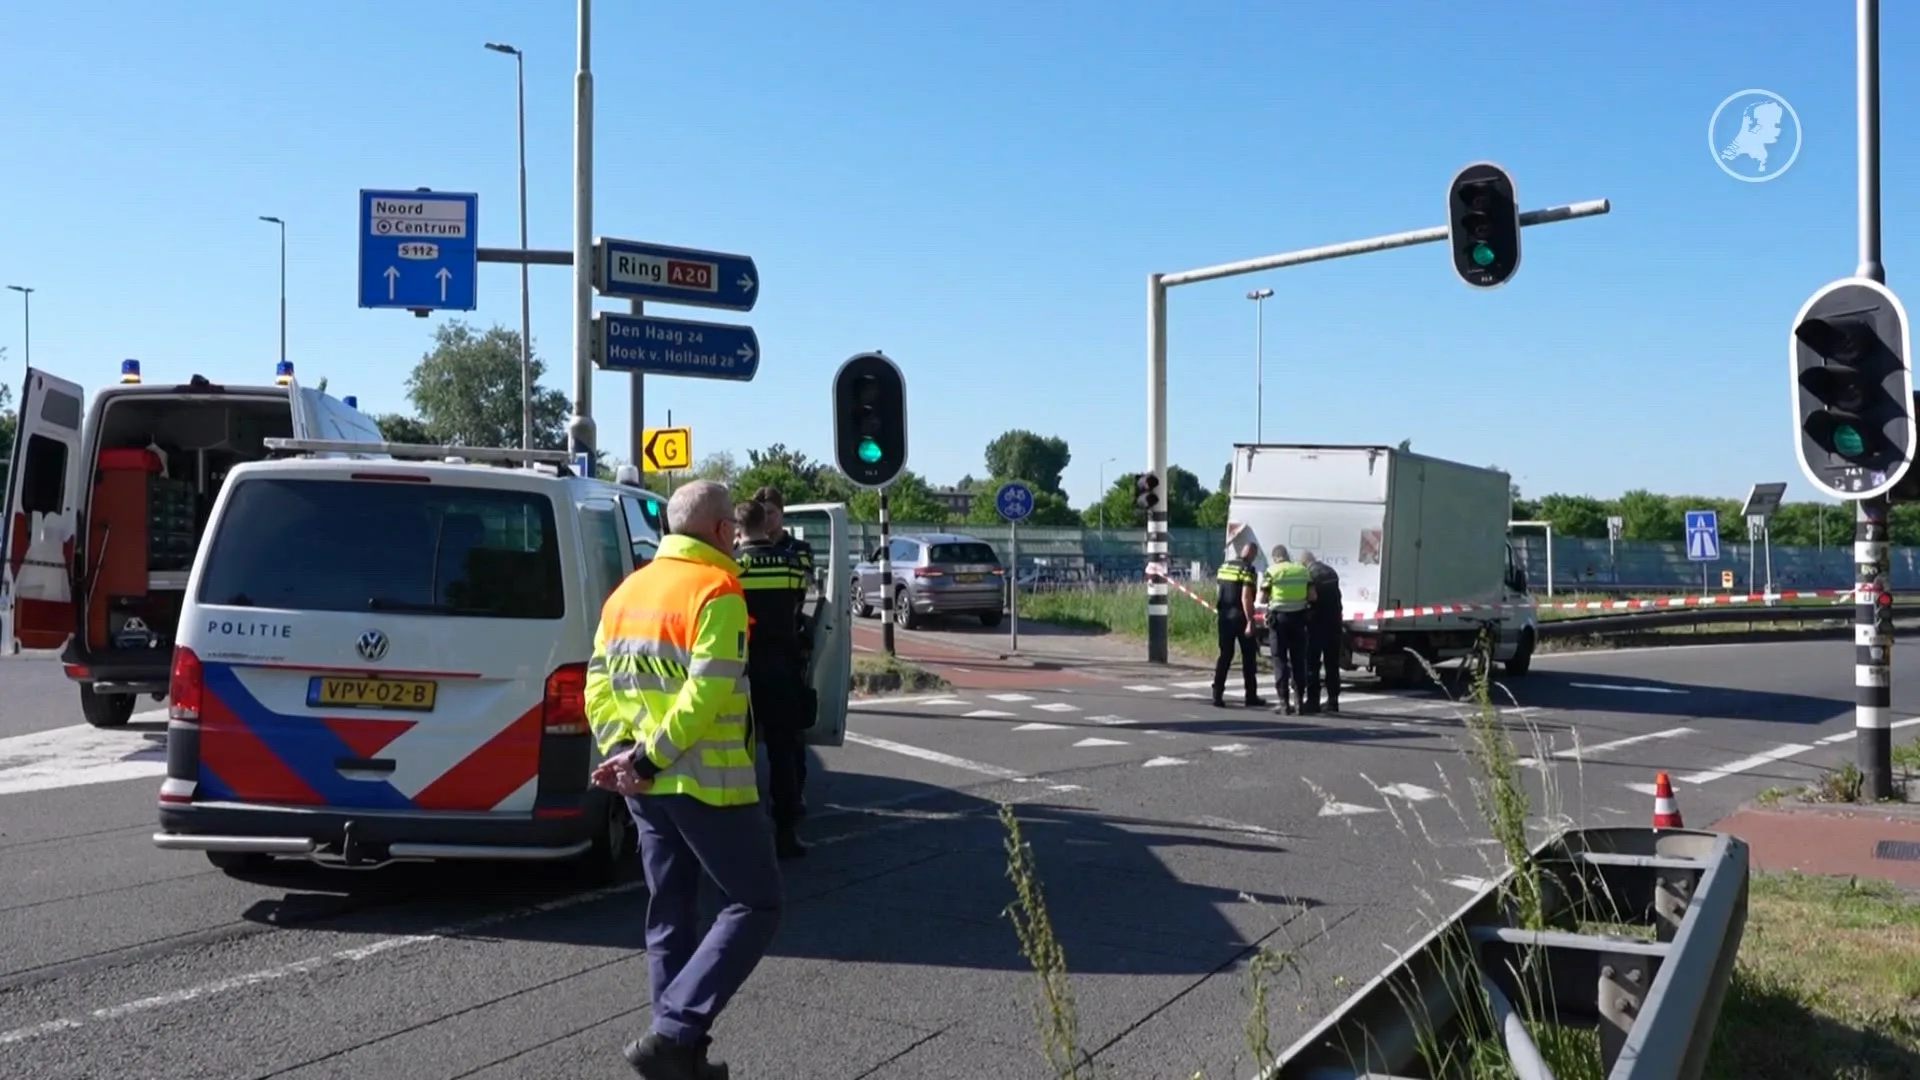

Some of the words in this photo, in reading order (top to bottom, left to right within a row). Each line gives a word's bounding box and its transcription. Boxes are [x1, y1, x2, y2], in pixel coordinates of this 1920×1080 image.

[376, 201, 423, 215] Noord
[395, 221, 461, 234] Centrum
[401, 246, 433, 256] S112
[618, 256, 662, 282] Ring
[672, 266, 707, 284] A20
[610, 322, 640, 338] Den
[645, 326, 683, 345] Haag
[688, 333, 703, 343] 24
[610, 345, 645, 360] Hoek
[649, 352, 661, 361] v.
[665, 350, 717, 366] Holland
[664, 438, 677, 461] G
[207, 621, 292, 638] POLITIE
[327, 680, 426, 703] VPV-02-B
